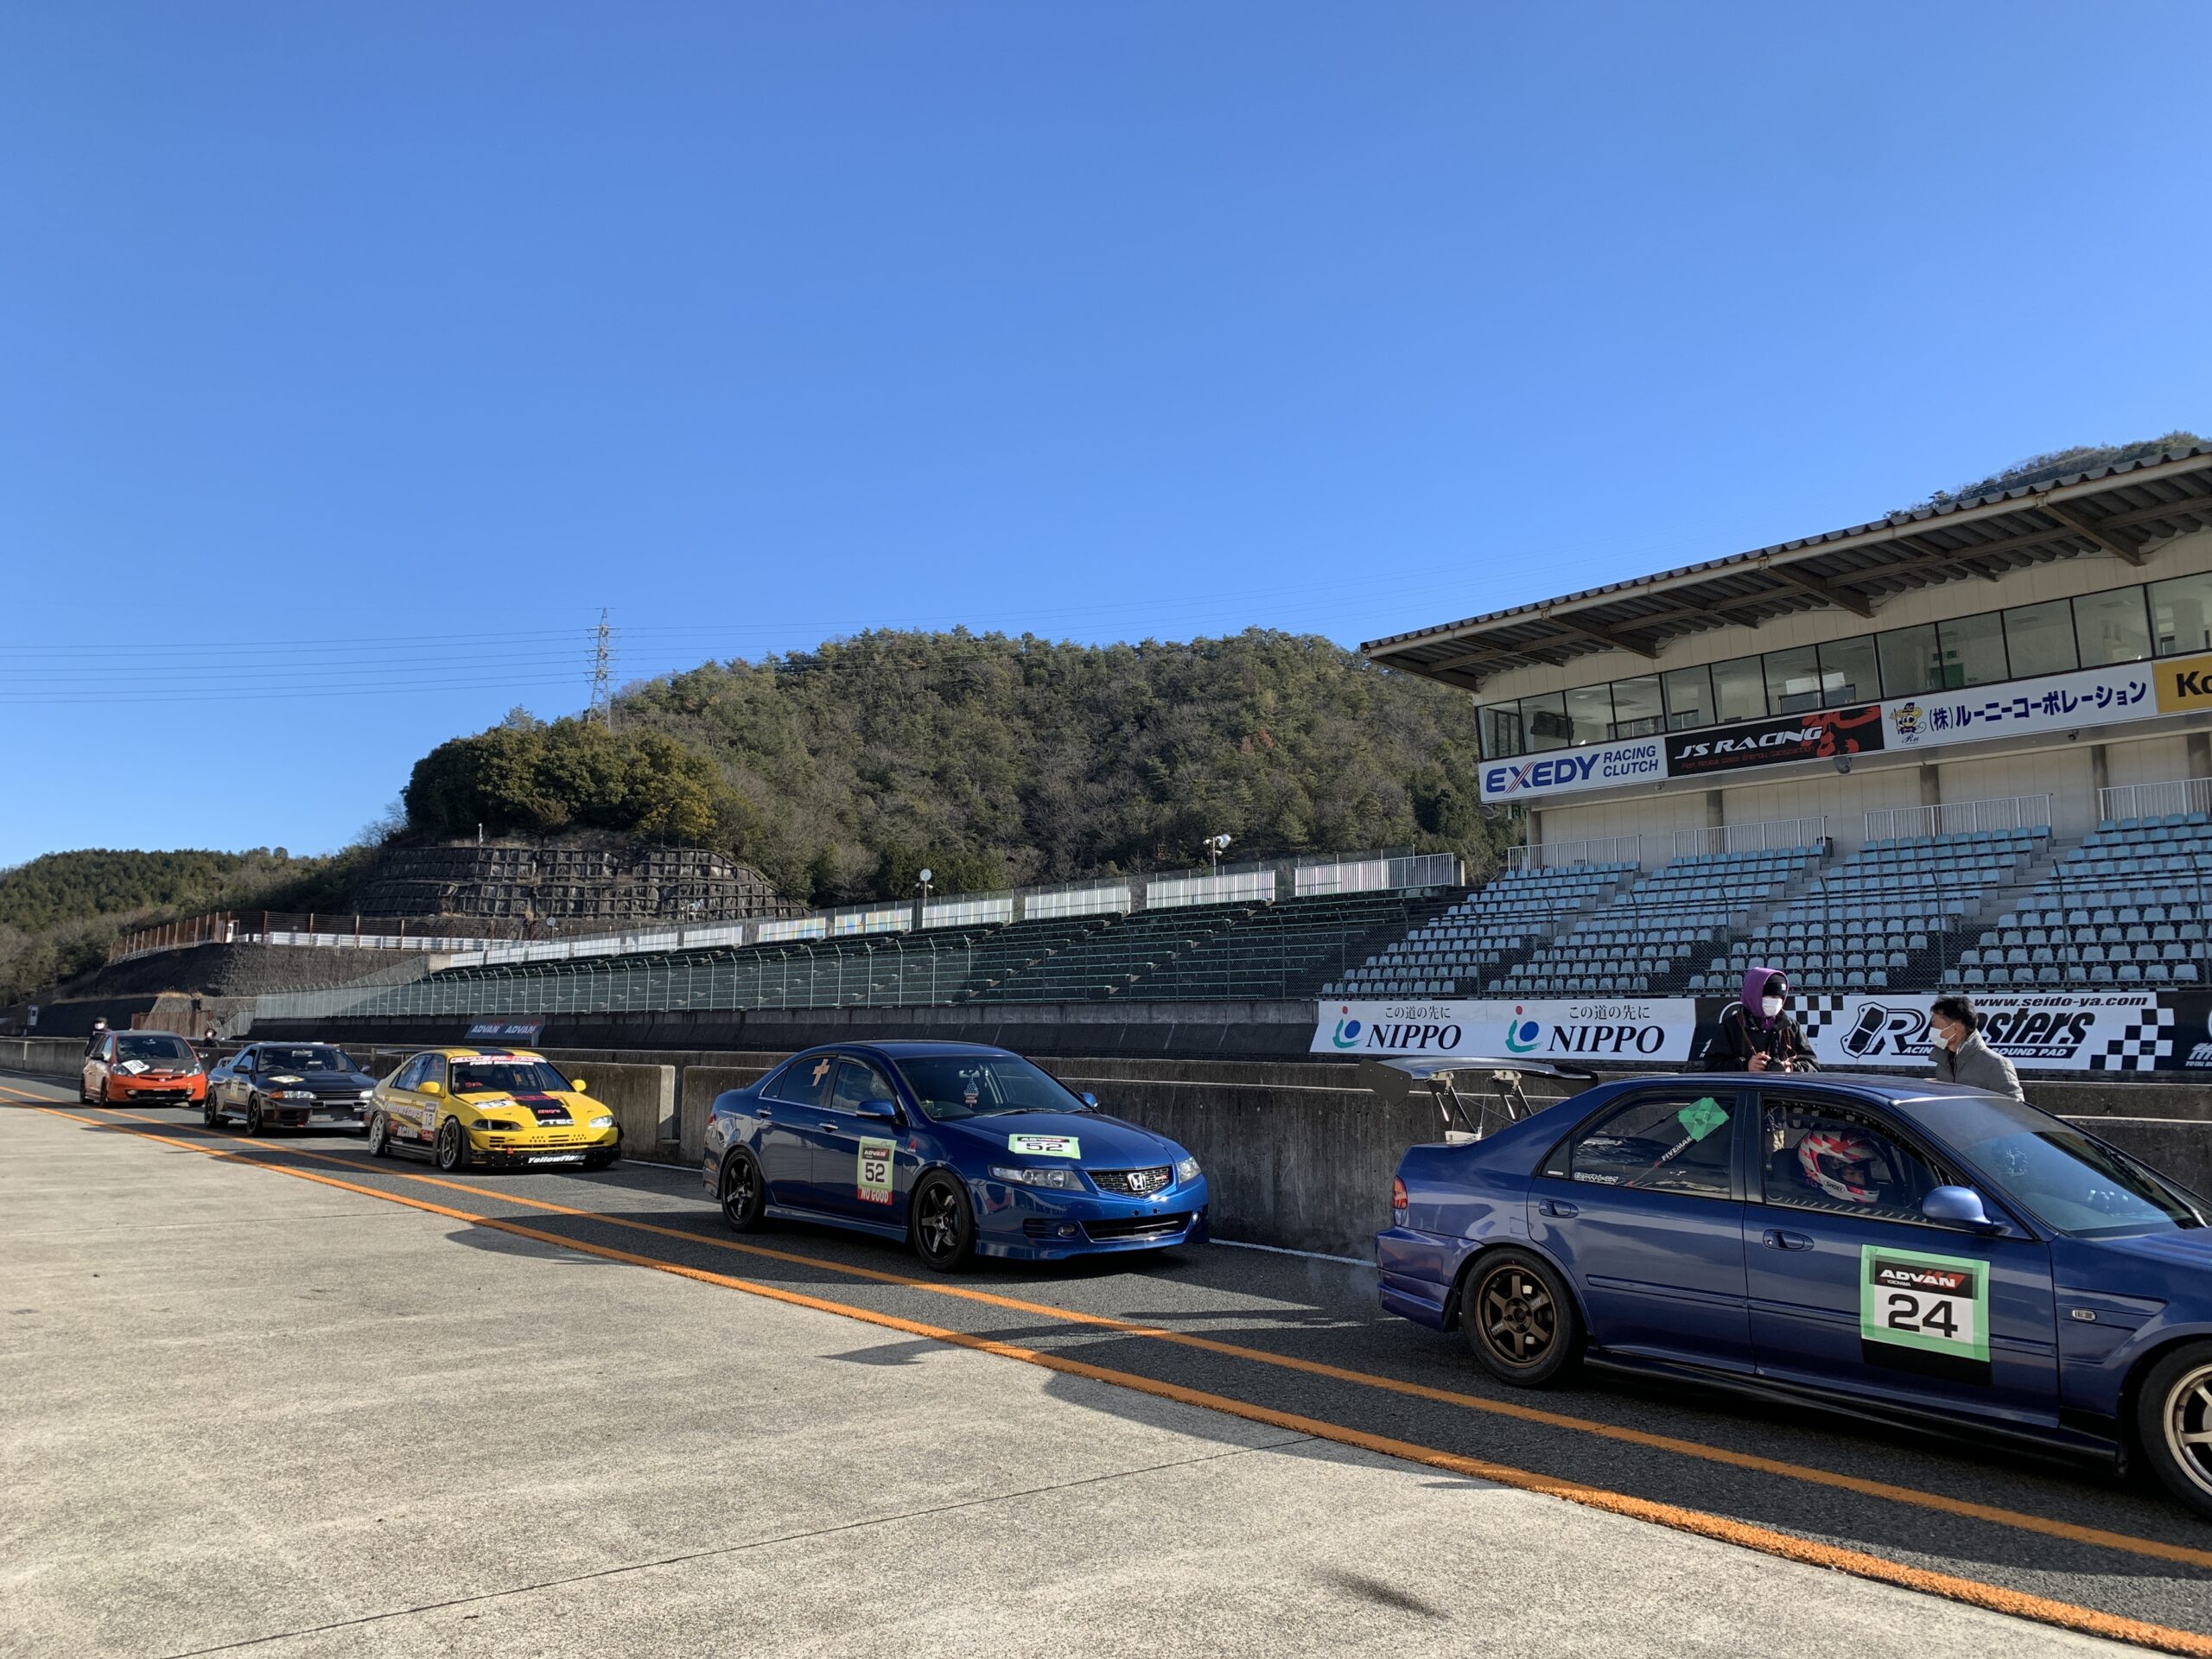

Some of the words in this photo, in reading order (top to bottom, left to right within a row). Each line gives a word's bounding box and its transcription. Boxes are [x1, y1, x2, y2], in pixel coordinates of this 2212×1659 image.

[1929, 681, 2146, 732] (株)ルーニーコーポレーション
[1714, 727, 1822, 754] RACING
[1604, 745, 1656, 764] RACING
[1485, 753, 1600, 795] EXEDY
[1604, 759, 1658, 778] CLUTCH
[1974, 996, 2148, 1007] www.seido-ya.com
[1385, 1005, 1451, 1020] この道の先に
[1569, 1005, 1650, 1020] この道の先に
[471, 1025, 500, 1033] ADVAN
[505, 1025, 537, 1033] ADVAN
[1366, 1024, 1461, 1050] NIPPO
[1548, 1025, 1665, 1053] NIPPO
[2037, 1048, 2067, 1057] PAD
[1026, 1142, 1064, 1151] 52
[865, 1161, 885, 1183] 52
[861, 1187, 871, 1199] NO
[871, 1189, 889, 1204] GOOD
[1879, 1268, 1956, 1288] ADVAN
[1888, 1293, 1959, 1338] 24
